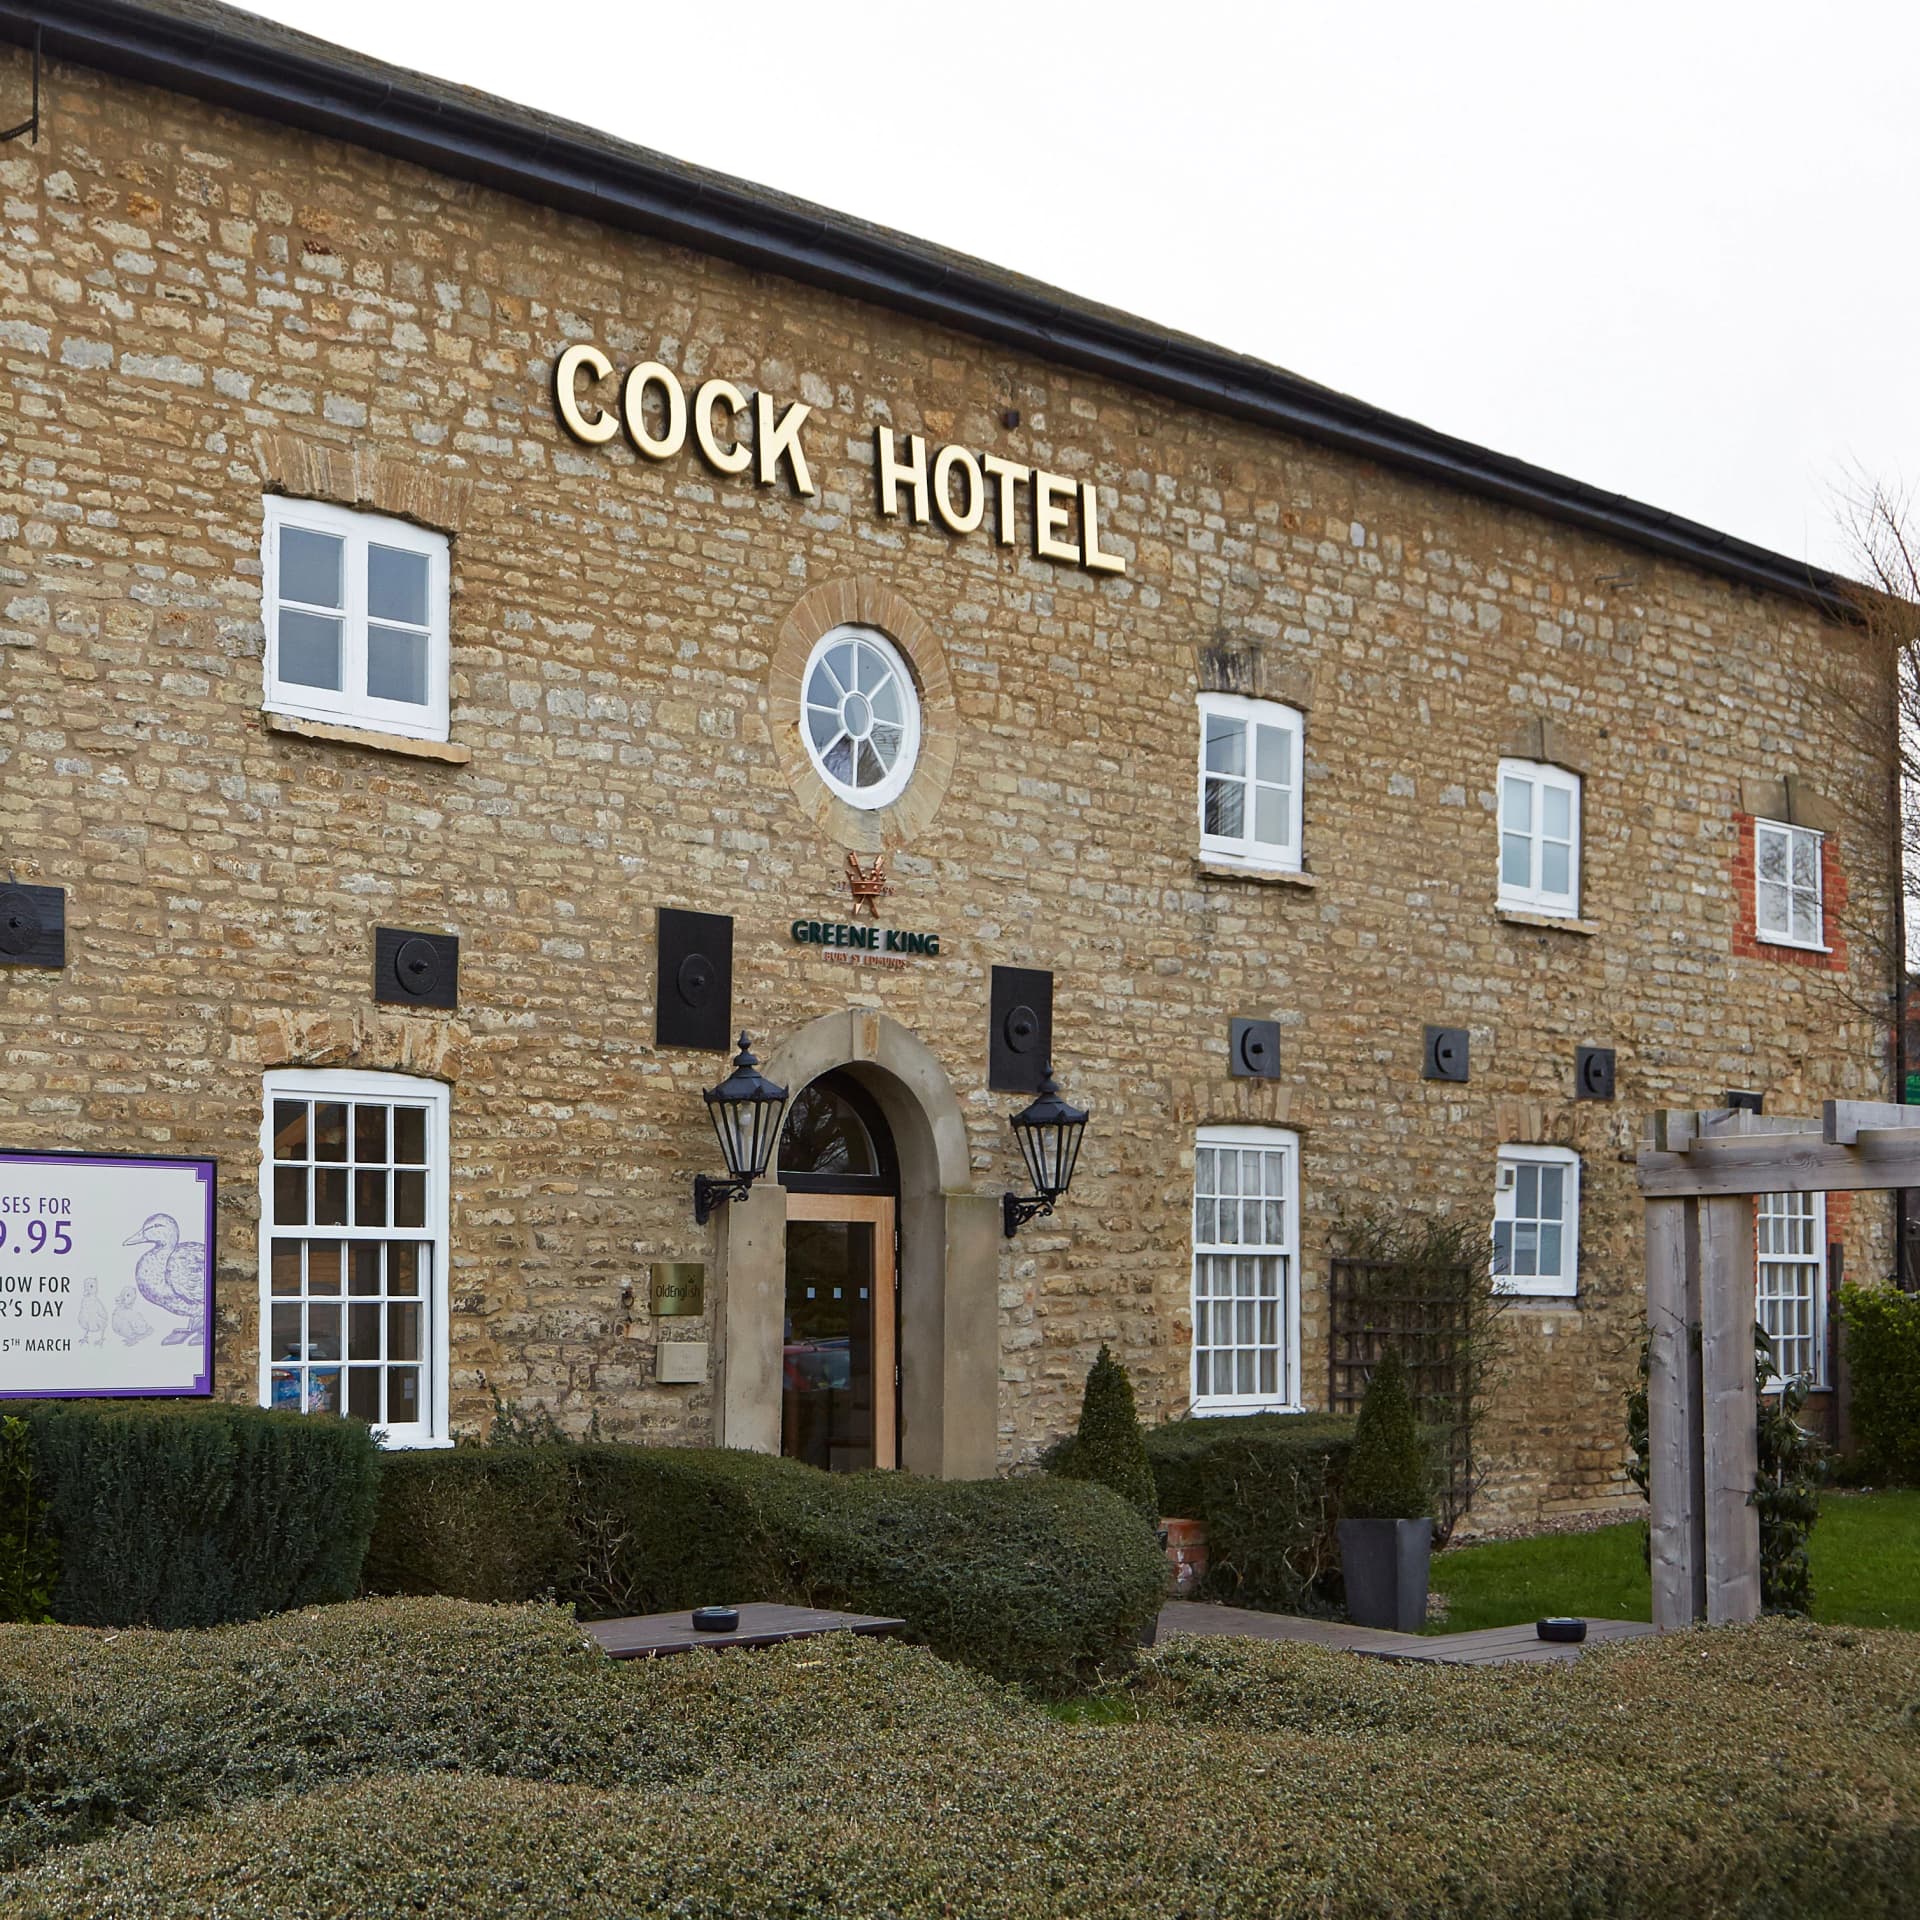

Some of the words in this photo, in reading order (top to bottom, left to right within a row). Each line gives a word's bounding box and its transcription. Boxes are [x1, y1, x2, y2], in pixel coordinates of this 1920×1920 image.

[556, 344, 815, 497] COCK
[877, 425, 1126, 574] HOTEL
[791, 920, 880, 949] GREENE
[886, 930, 940, 955] KING
[2, 1196, 31, 1213] SES
[39, 1197, 71, 1215] FOR
[0, 1276, 32, 1293] OW
[39, 1276, 70, 1293] FOR
[31, 1300, 64, 1317] DAY
[25, 1338, 71, 1352] MARCH
